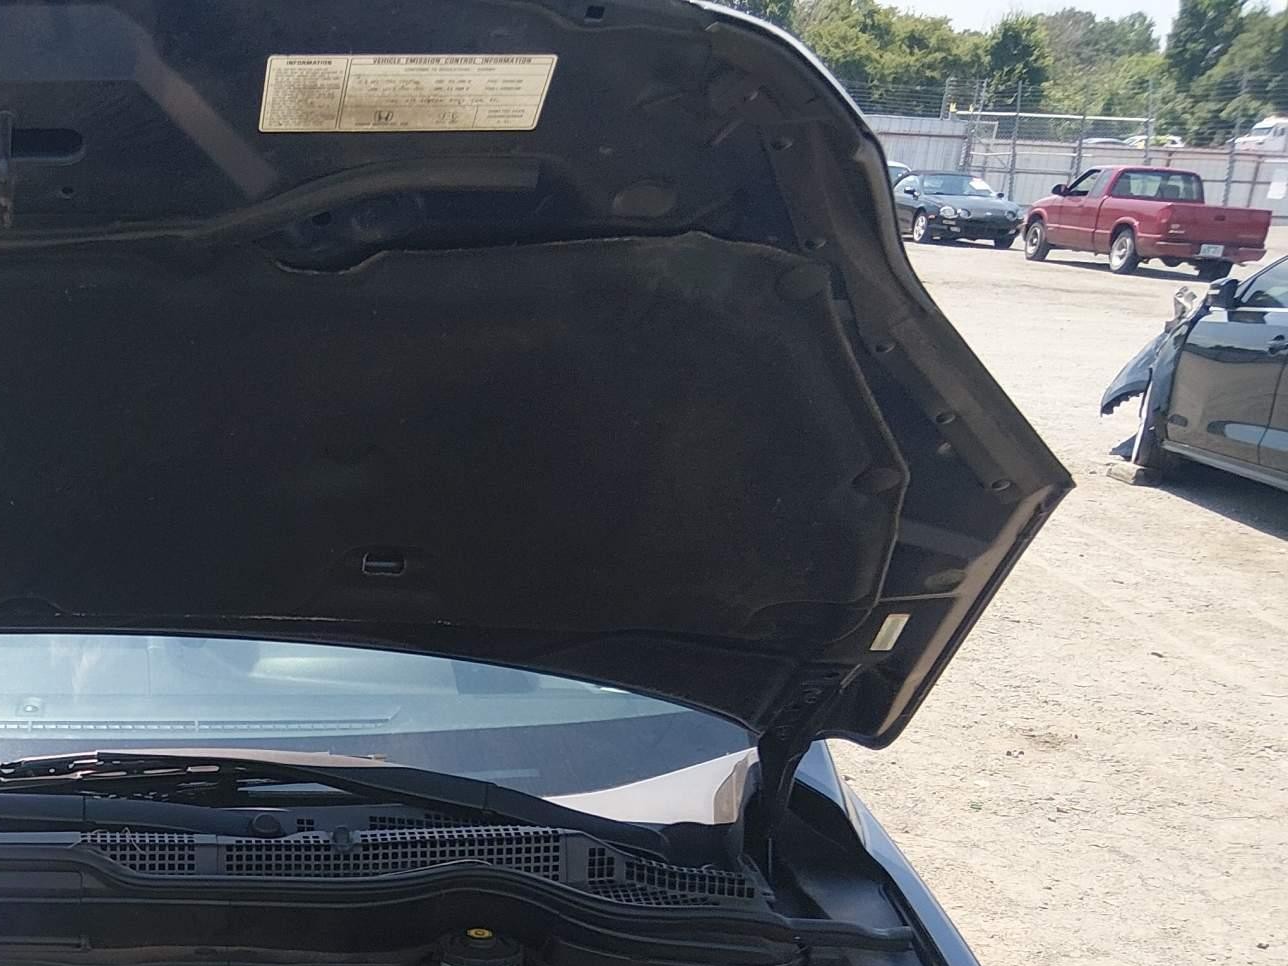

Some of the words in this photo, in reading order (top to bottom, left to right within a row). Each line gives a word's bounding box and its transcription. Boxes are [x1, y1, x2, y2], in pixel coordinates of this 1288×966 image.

[372, 56, 401, 65] VEHICLE
[405, 56, 441, 65] EMISSION
[444, 56, 477, 65] CONTROL
[481, 56, 533, 65] INFORMATION
